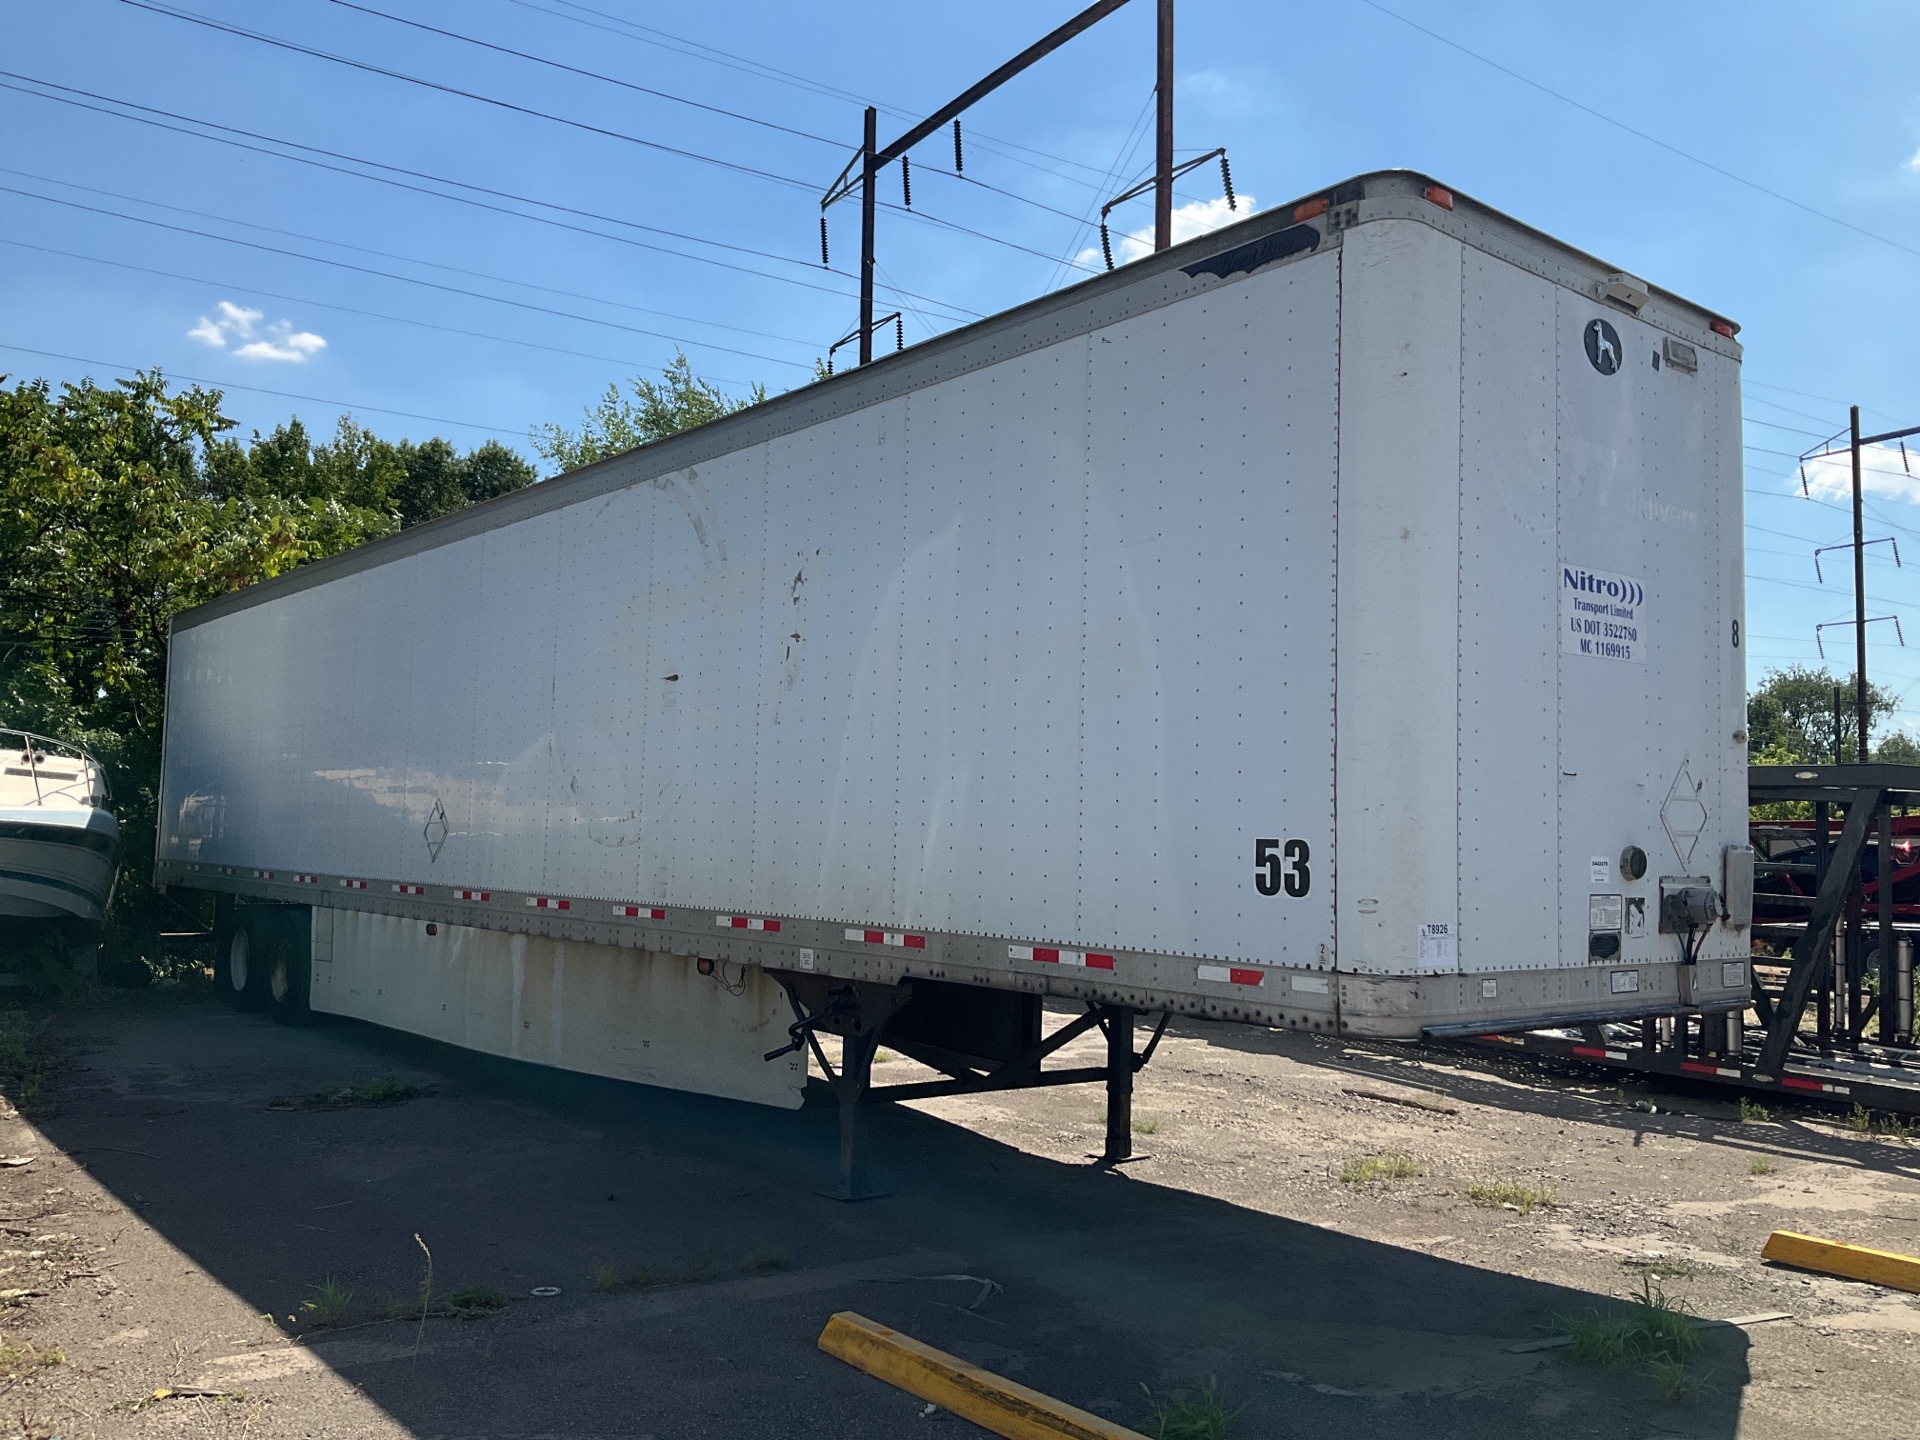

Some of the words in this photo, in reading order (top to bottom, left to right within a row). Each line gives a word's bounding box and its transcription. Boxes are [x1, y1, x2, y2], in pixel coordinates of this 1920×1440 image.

[1573, 597, 1609, 615] Transport
[1610, 604, 1634, 620] Limited
[1571, 617, 1582, 632] US
[1584, 620, 1601, 635] DOT
[1732, 619, 1739, 648] 8
[1580, 638, 1593, 654] MC
[1595, 641, 1631, 659] 1169915
[1255, 838, 1311, 898] 53
[1427, 924, 1449, 935] T8926
